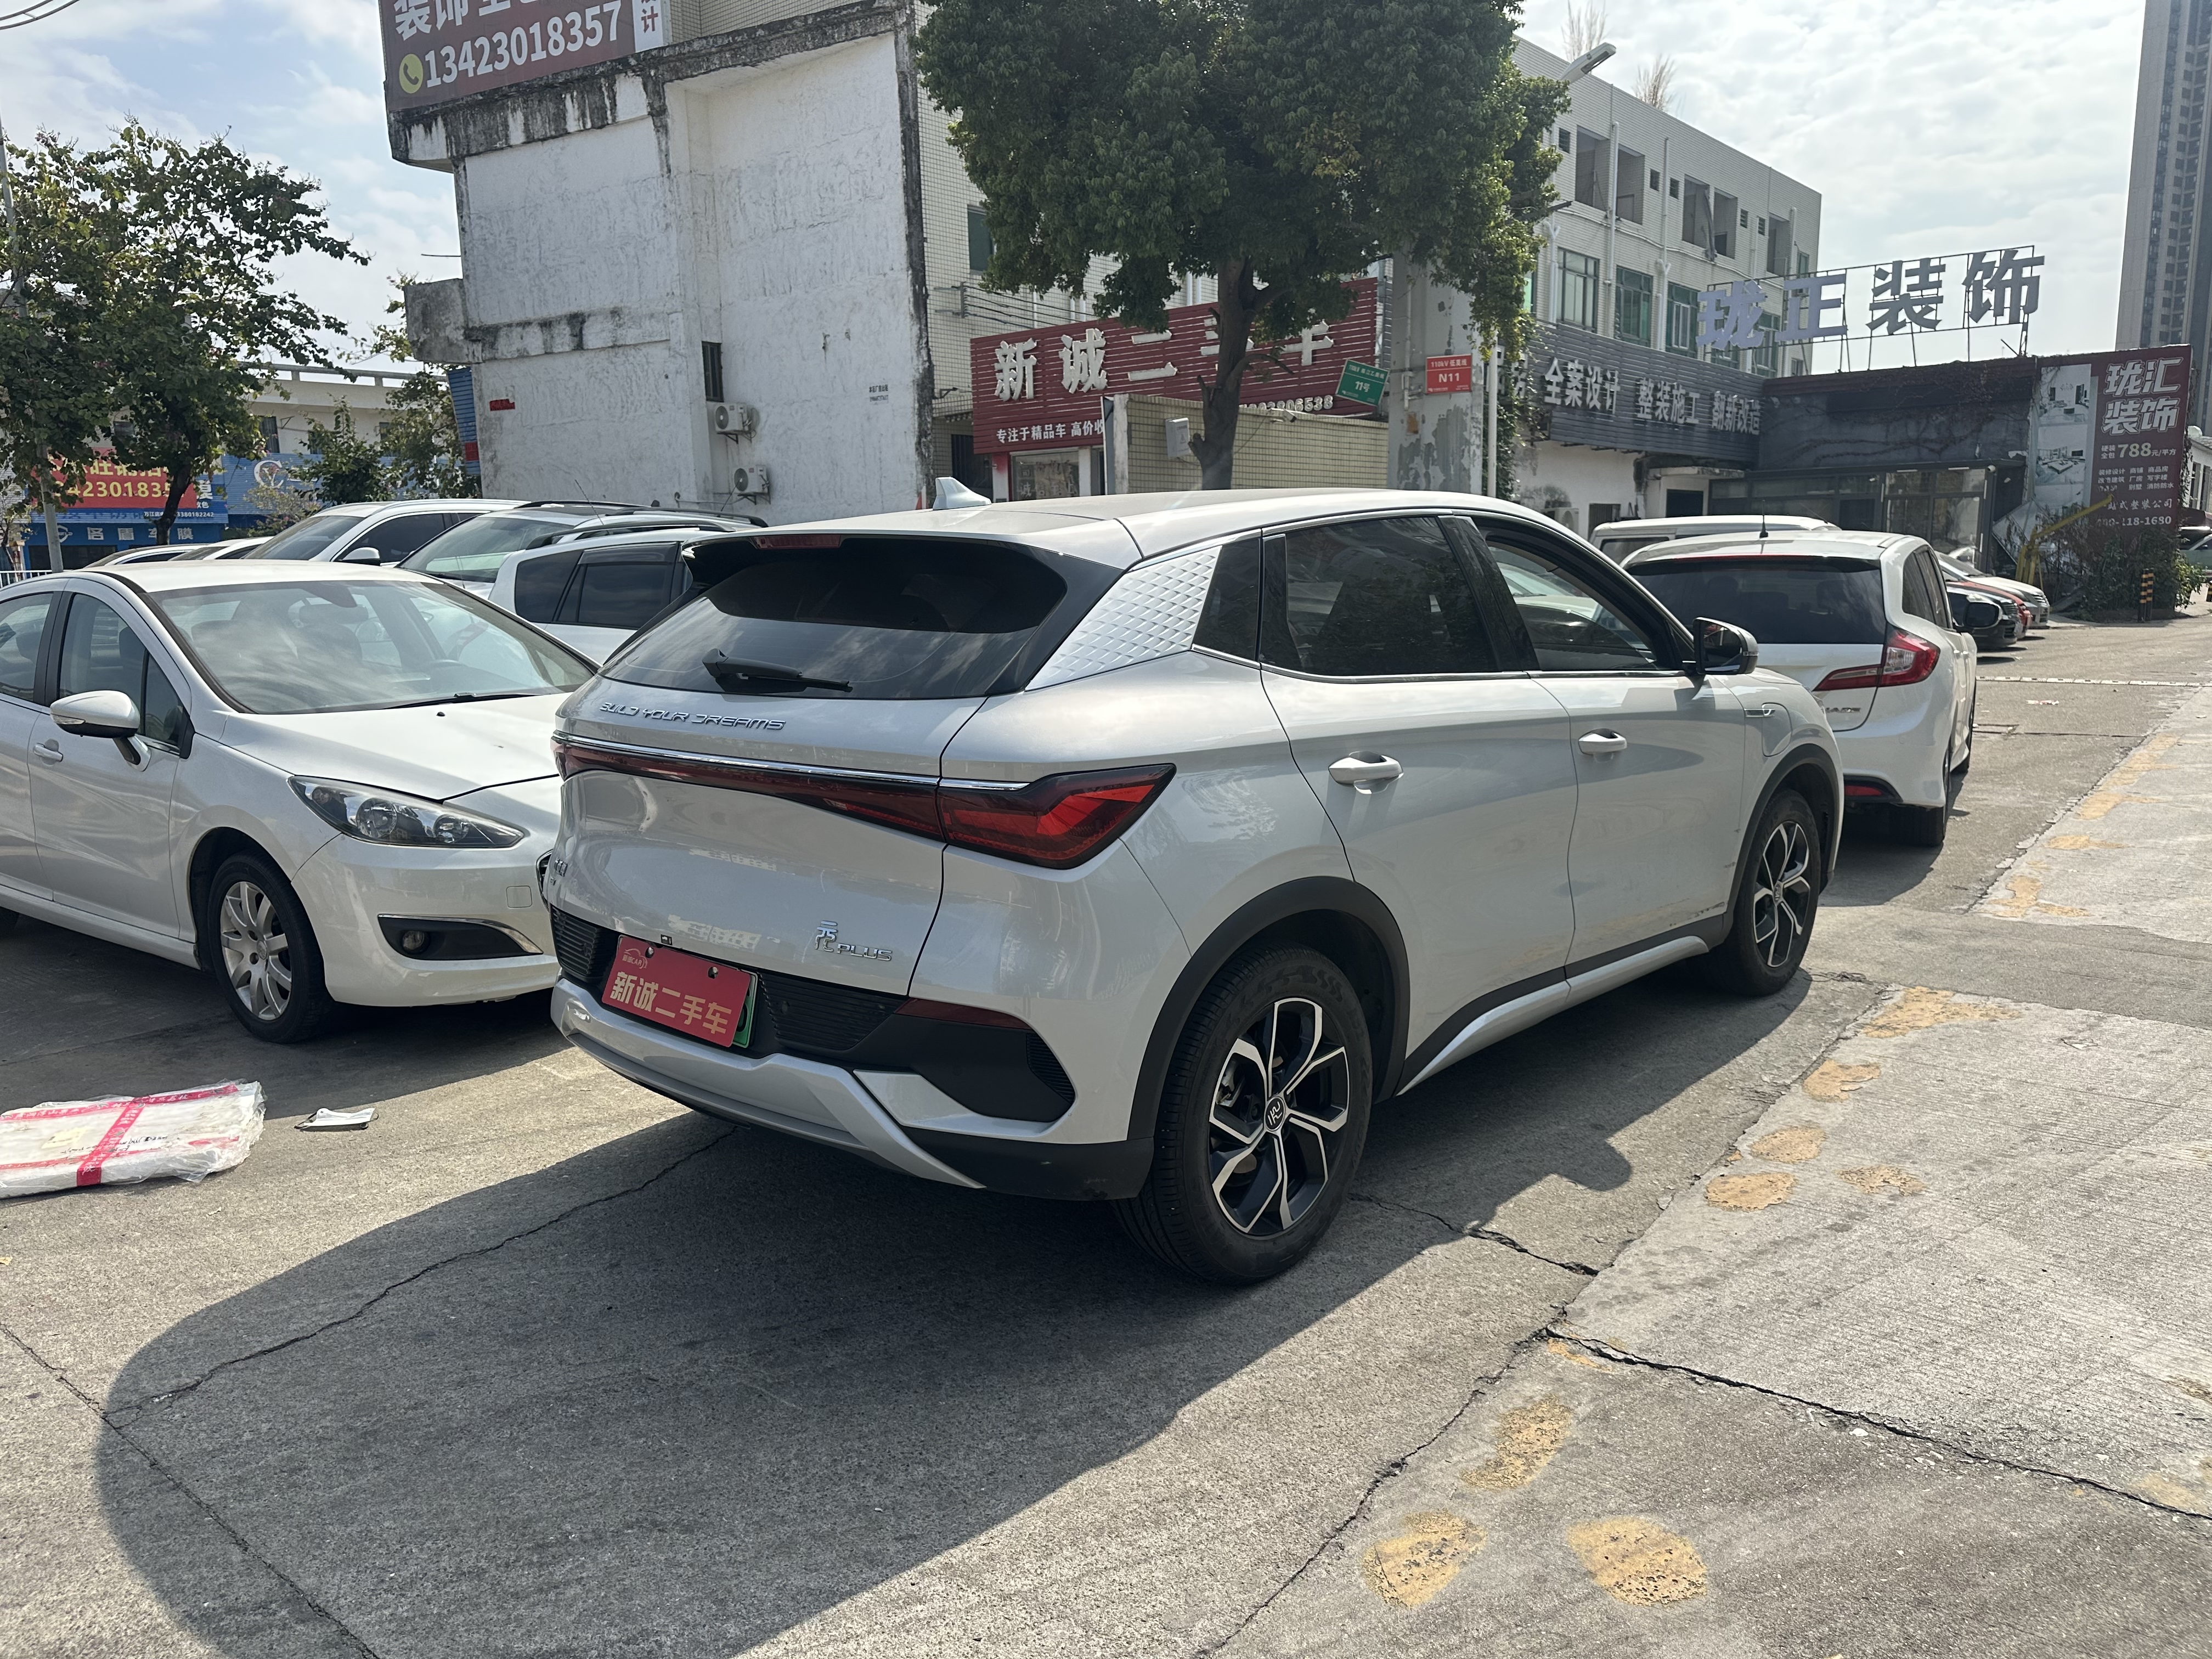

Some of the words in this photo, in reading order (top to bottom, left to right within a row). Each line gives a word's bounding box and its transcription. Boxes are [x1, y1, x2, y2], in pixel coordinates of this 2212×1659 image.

[641, 0, 658, 33] 计
[425, 0, 622, 87] 13423018357
[994, 319, 1334, 401] 新诚二车
[1355, 381, 1370, 392] 11号
[1438, 373, 1459, 383] N11
[1544, 357, 1621, 414] 全案设计
[2102, 397, 2180, 435] 装饰
[996, 423, 1066, 444] 专注于精品车
[2104, 498, 2172, 510] 站式整装公司
[599, 702, 640, 716] BUILD
[642, 708, 690, 722] YOUR
[691, 714, 786, 731] DREAMS
[837, 943, 893, 962] PLUS
[610, 971, 732, 1035] 新诚二手车
